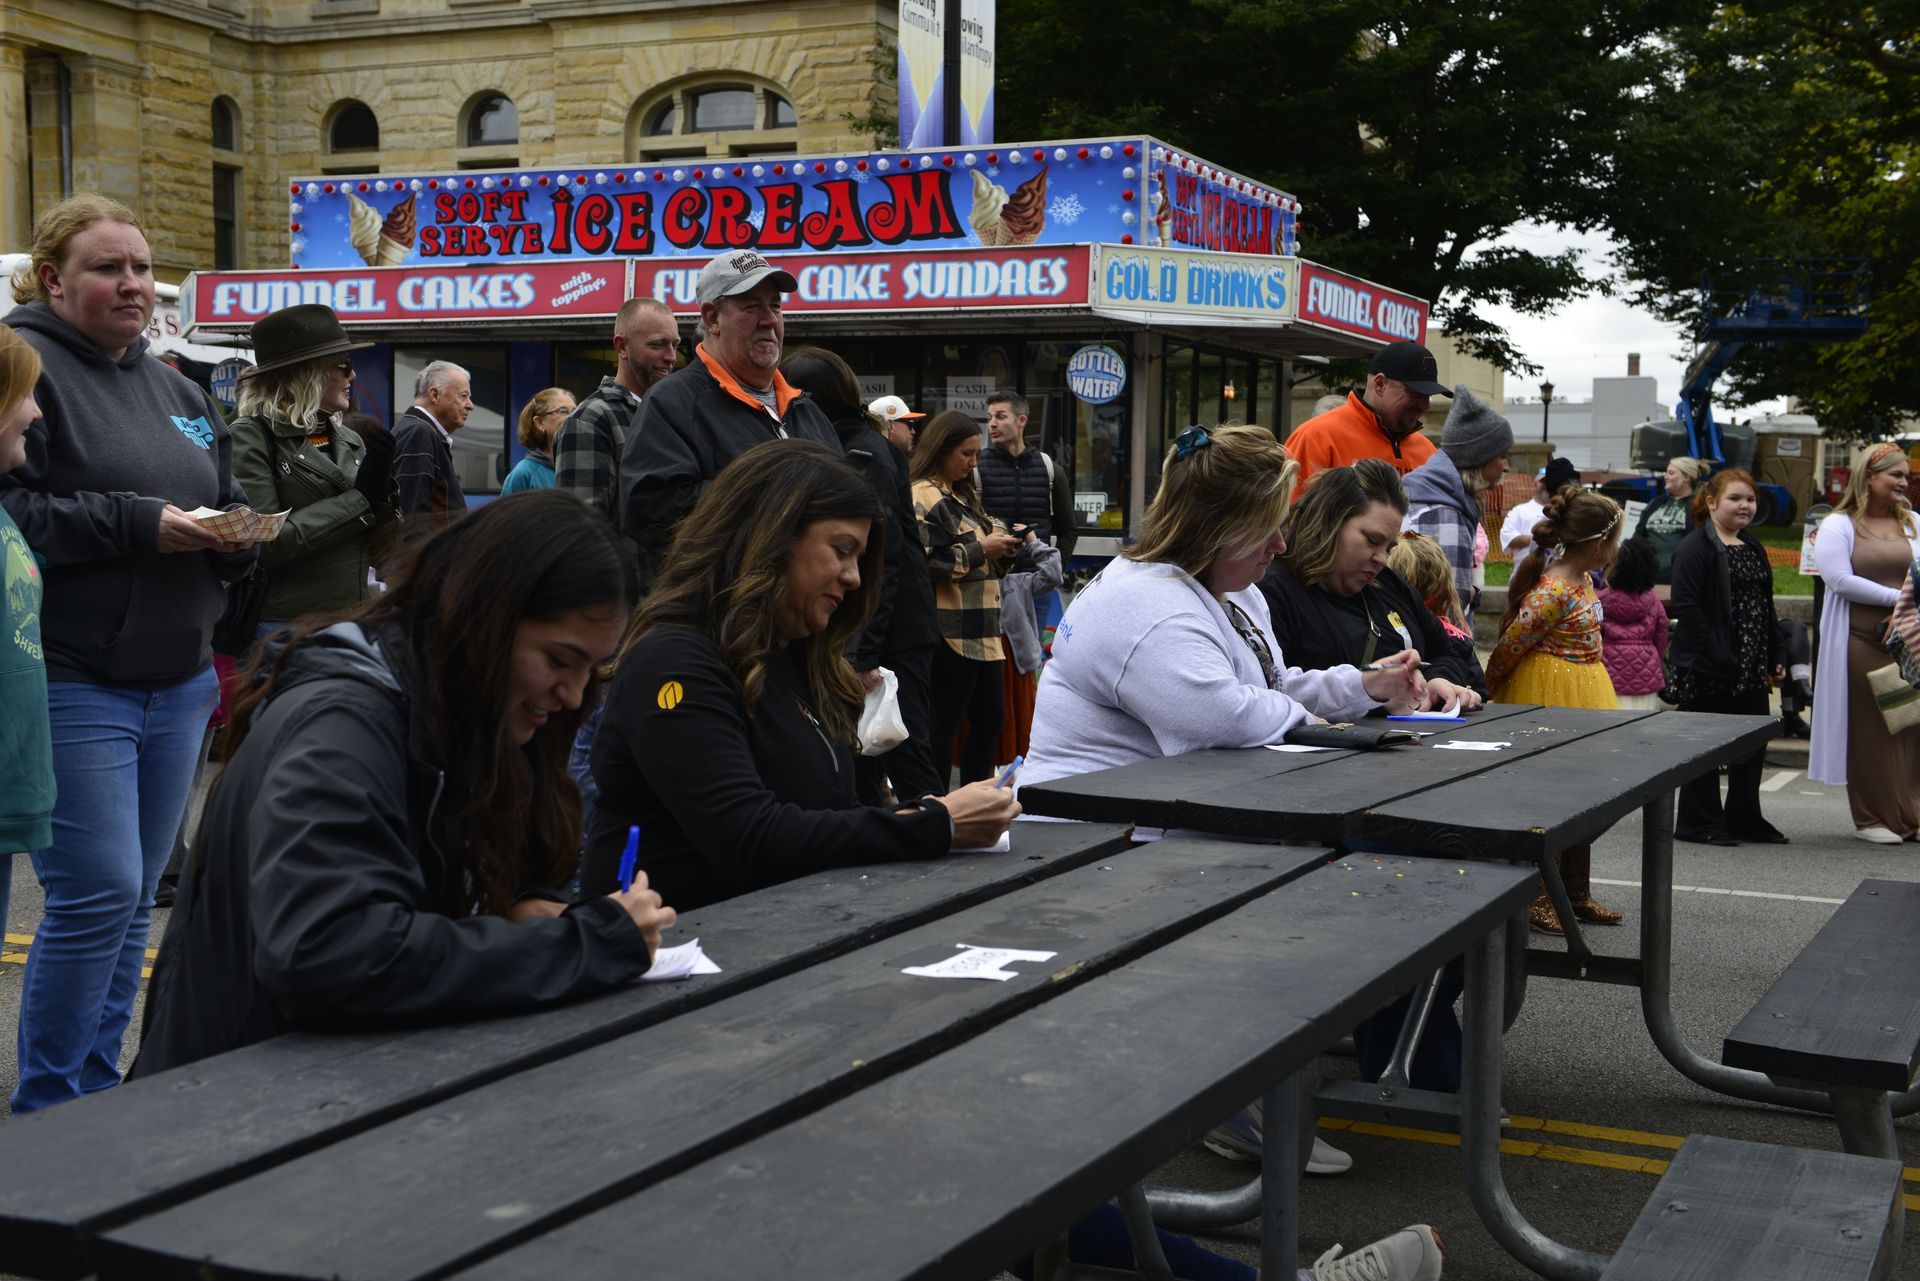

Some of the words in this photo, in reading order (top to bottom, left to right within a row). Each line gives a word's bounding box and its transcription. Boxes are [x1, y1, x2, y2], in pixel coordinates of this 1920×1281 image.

[419, 221, 544, 257] SERVE
[662, 168, 967, 250] CREAM
[435, 189, 530, 224] SOFT
[212, 278, 387, 316] FUNNEL
[397, 271, 537, 310] CAKES
[551, 277, 608, 308] toppings
[559, 270, 593, 293] with
[799, 263, 893, 301] CAKE
[902, 257, 1069, 301] SUNDAES
[1106, 254, 1178, 304] COLD
[1187, 258, 1287, 310] DRINKS
[1306, 275, 1374, 330] FUNNEL
[1377, 297, 1421, 342] CAKES
[212, 363, 241, 382] BOTT
[1069, 351, 1124, 378] BOTTLED
[955, 384, 987, 395] CASH
[1072, 376, 1119, 398] WATER
[954, 400, 987, 410] ONLY
[1076, 502, 1103, 513] NTER
